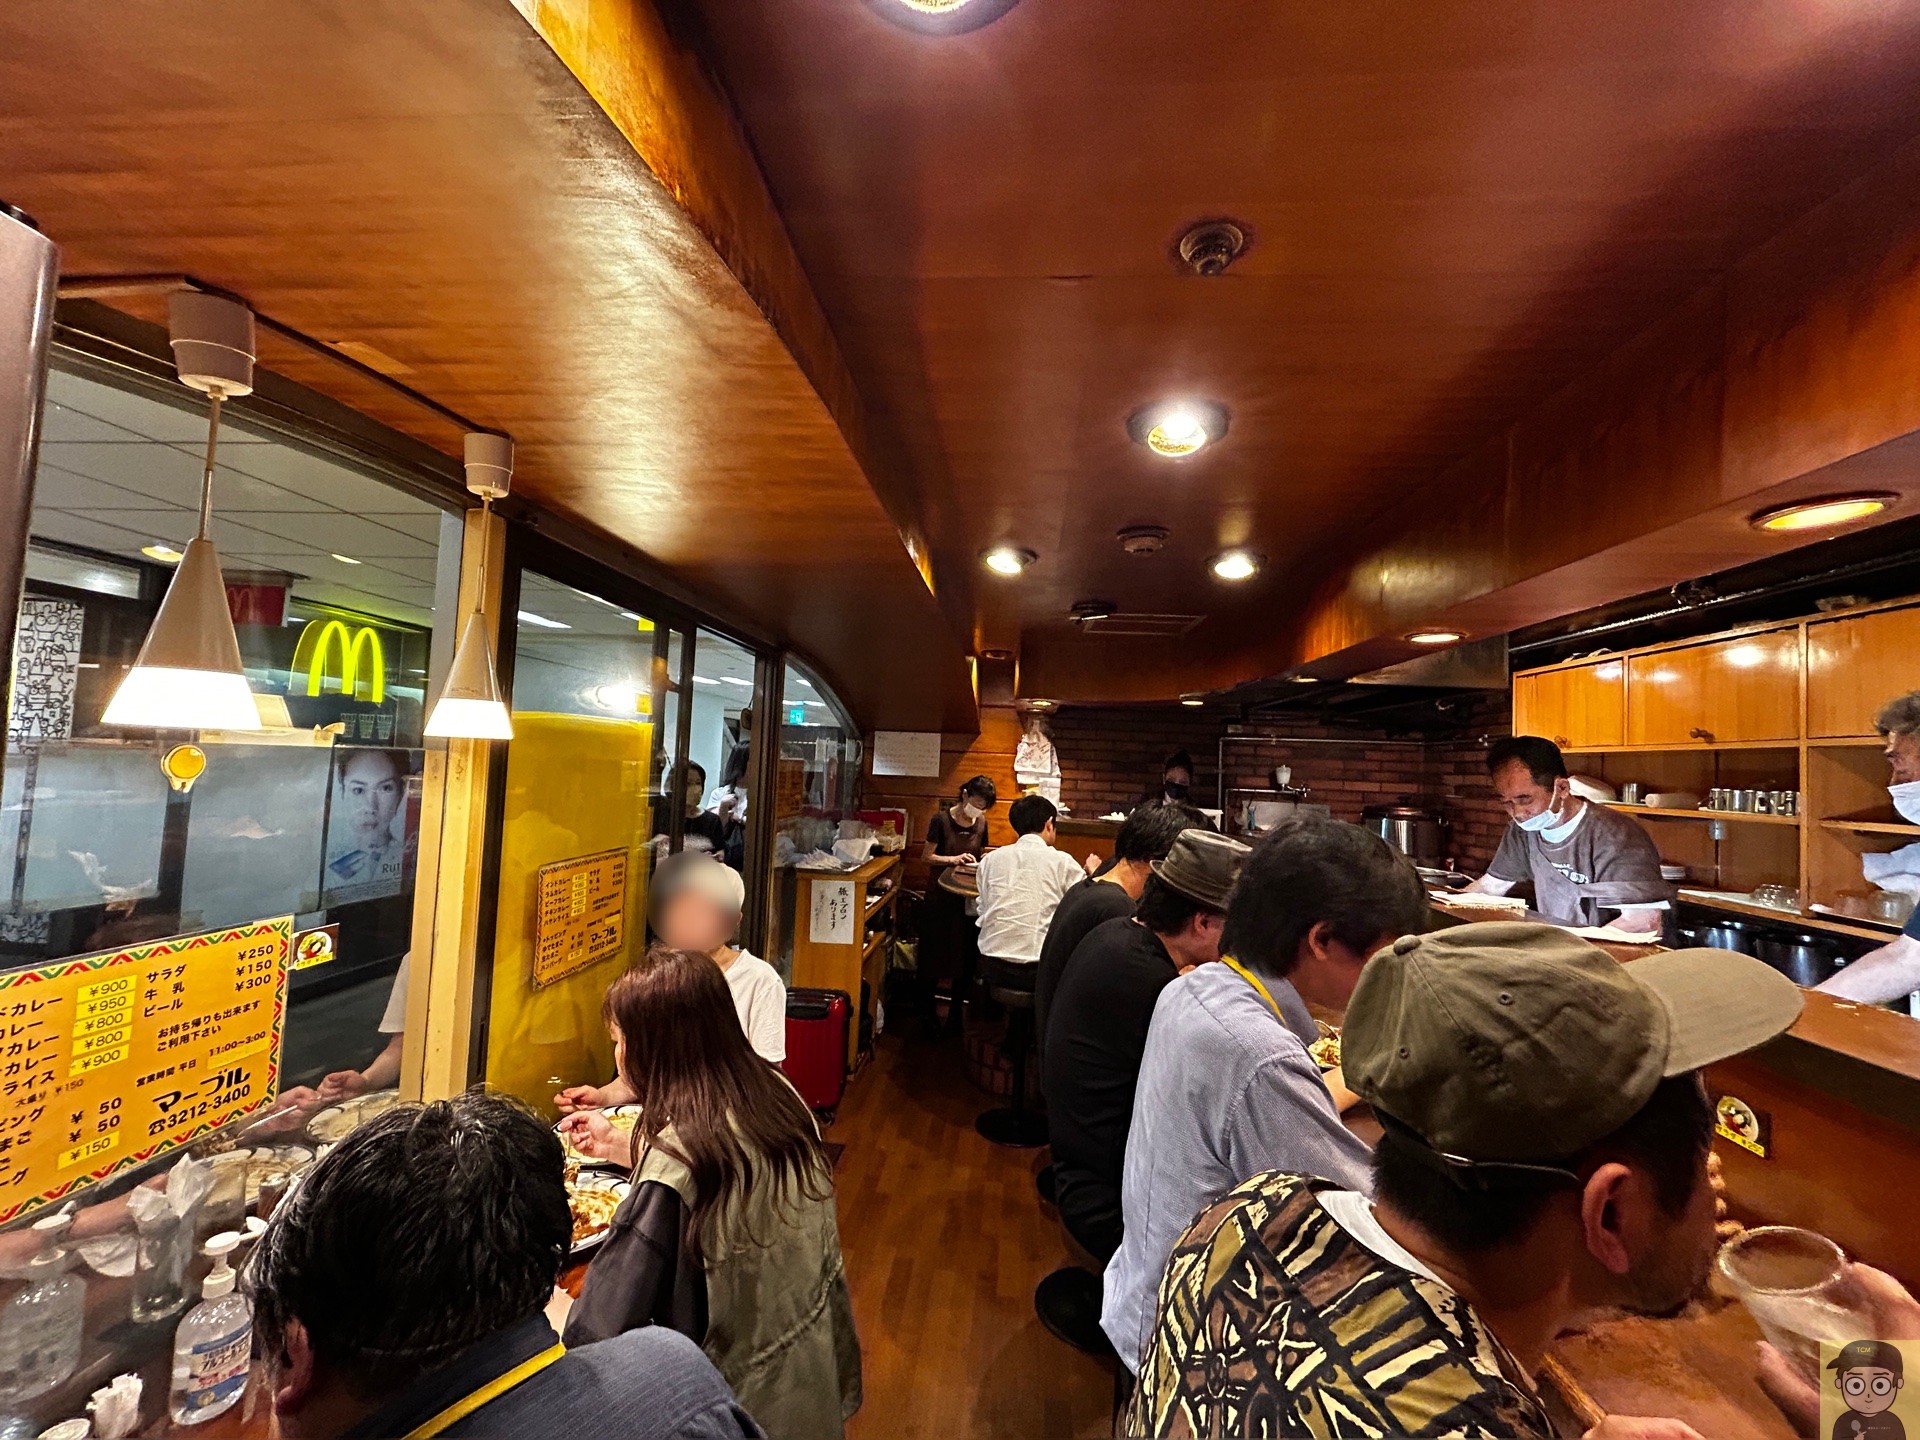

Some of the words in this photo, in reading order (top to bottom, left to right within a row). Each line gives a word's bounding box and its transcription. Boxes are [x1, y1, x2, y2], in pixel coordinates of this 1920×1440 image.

[146, 964, 187, 983] サラダ
[238, 944, 274, 961] ¥250
[236, 959, 272, 976] ¥150
[89, 979, 128, 997] ¥900
[143, 998, 184, 1018] ビール
[235, 974, 271, 992] ¥300
[87, 996, 127, 1014] ¥950
[157, 1000, 261, 1039] お持ち帰りも出来ます
[0, 1035, 60, 1057] カレー
[85, 1013, 124, 1031] ¥800
[157, 1025, 221, 1052] ご利用下さい
[0, 1054, 58, 1077] カレー
[84, 1031, 123, 1049] ¥800
[81, 1050, 121, 1069] ¥900
[152, 1067, 251, 1113] マーブル
[70, 1138, 111, 1161] ¥150
